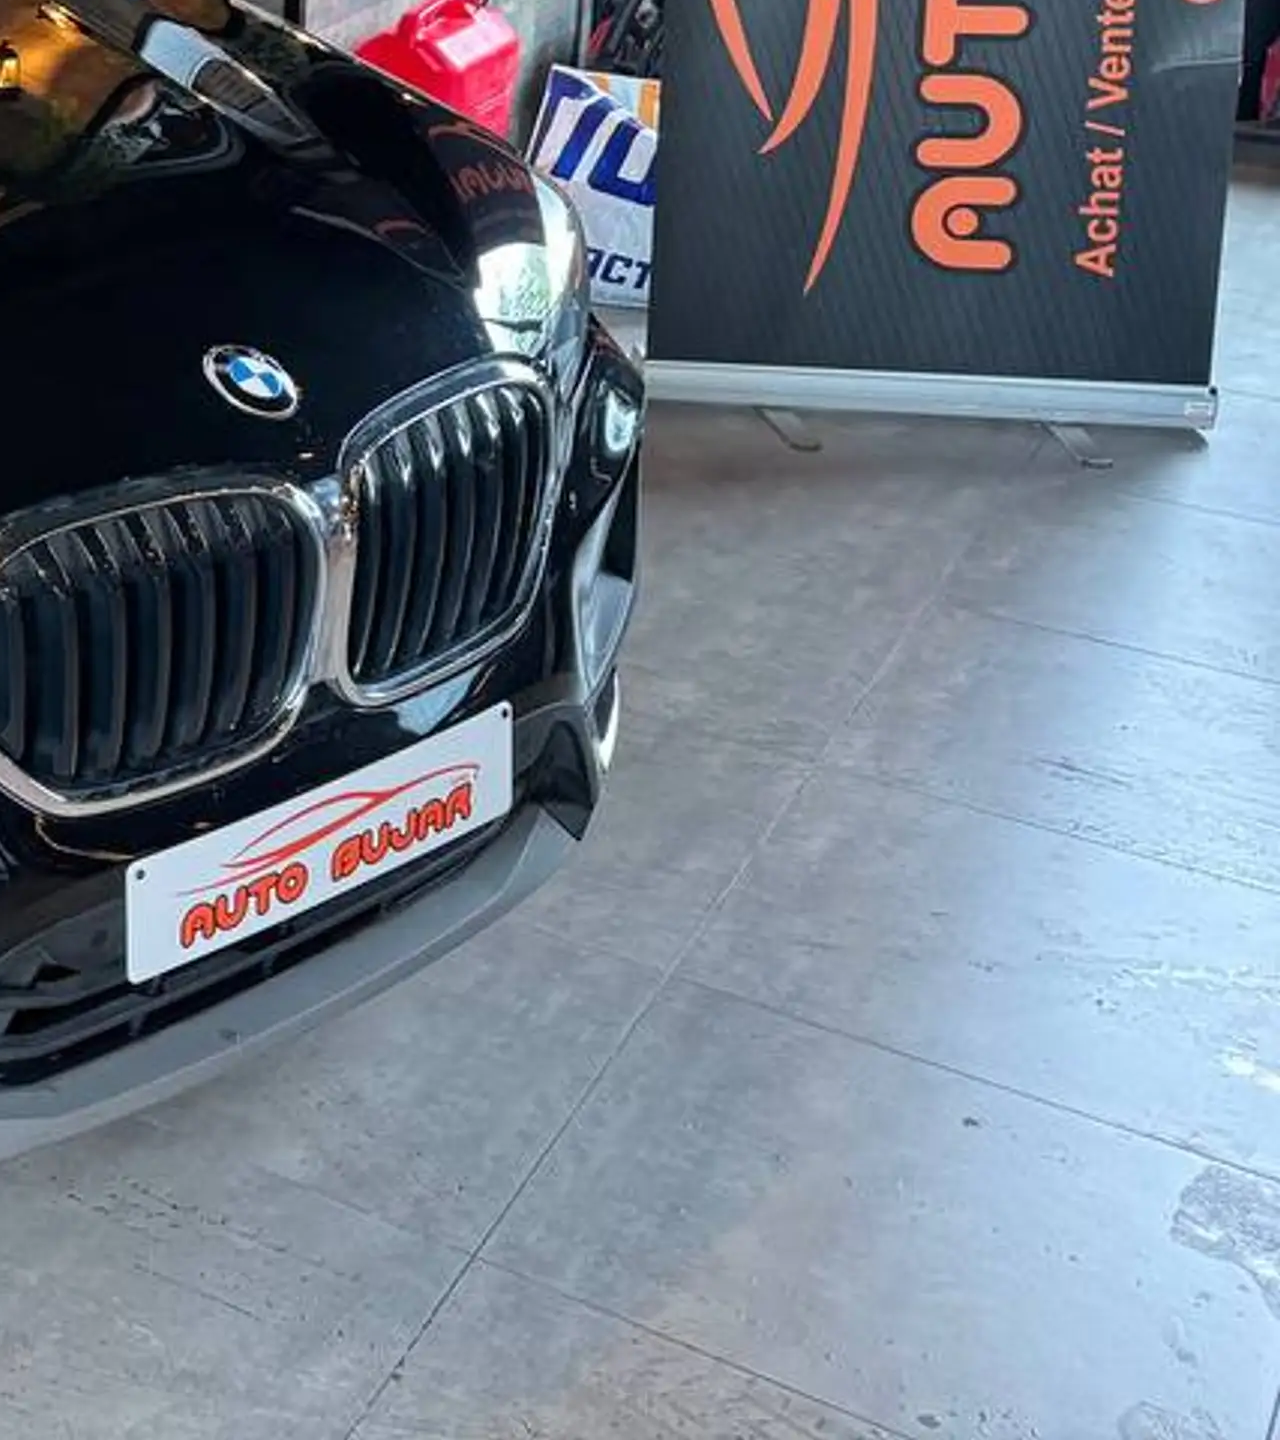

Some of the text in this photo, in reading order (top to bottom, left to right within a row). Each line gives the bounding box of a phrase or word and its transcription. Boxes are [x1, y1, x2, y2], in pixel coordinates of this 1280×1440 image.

[1085, 119, 1126, 137] /
[1075, 138, 1124, 277] Achat
[179, 781, 474, 949] AUTO BUJAR
